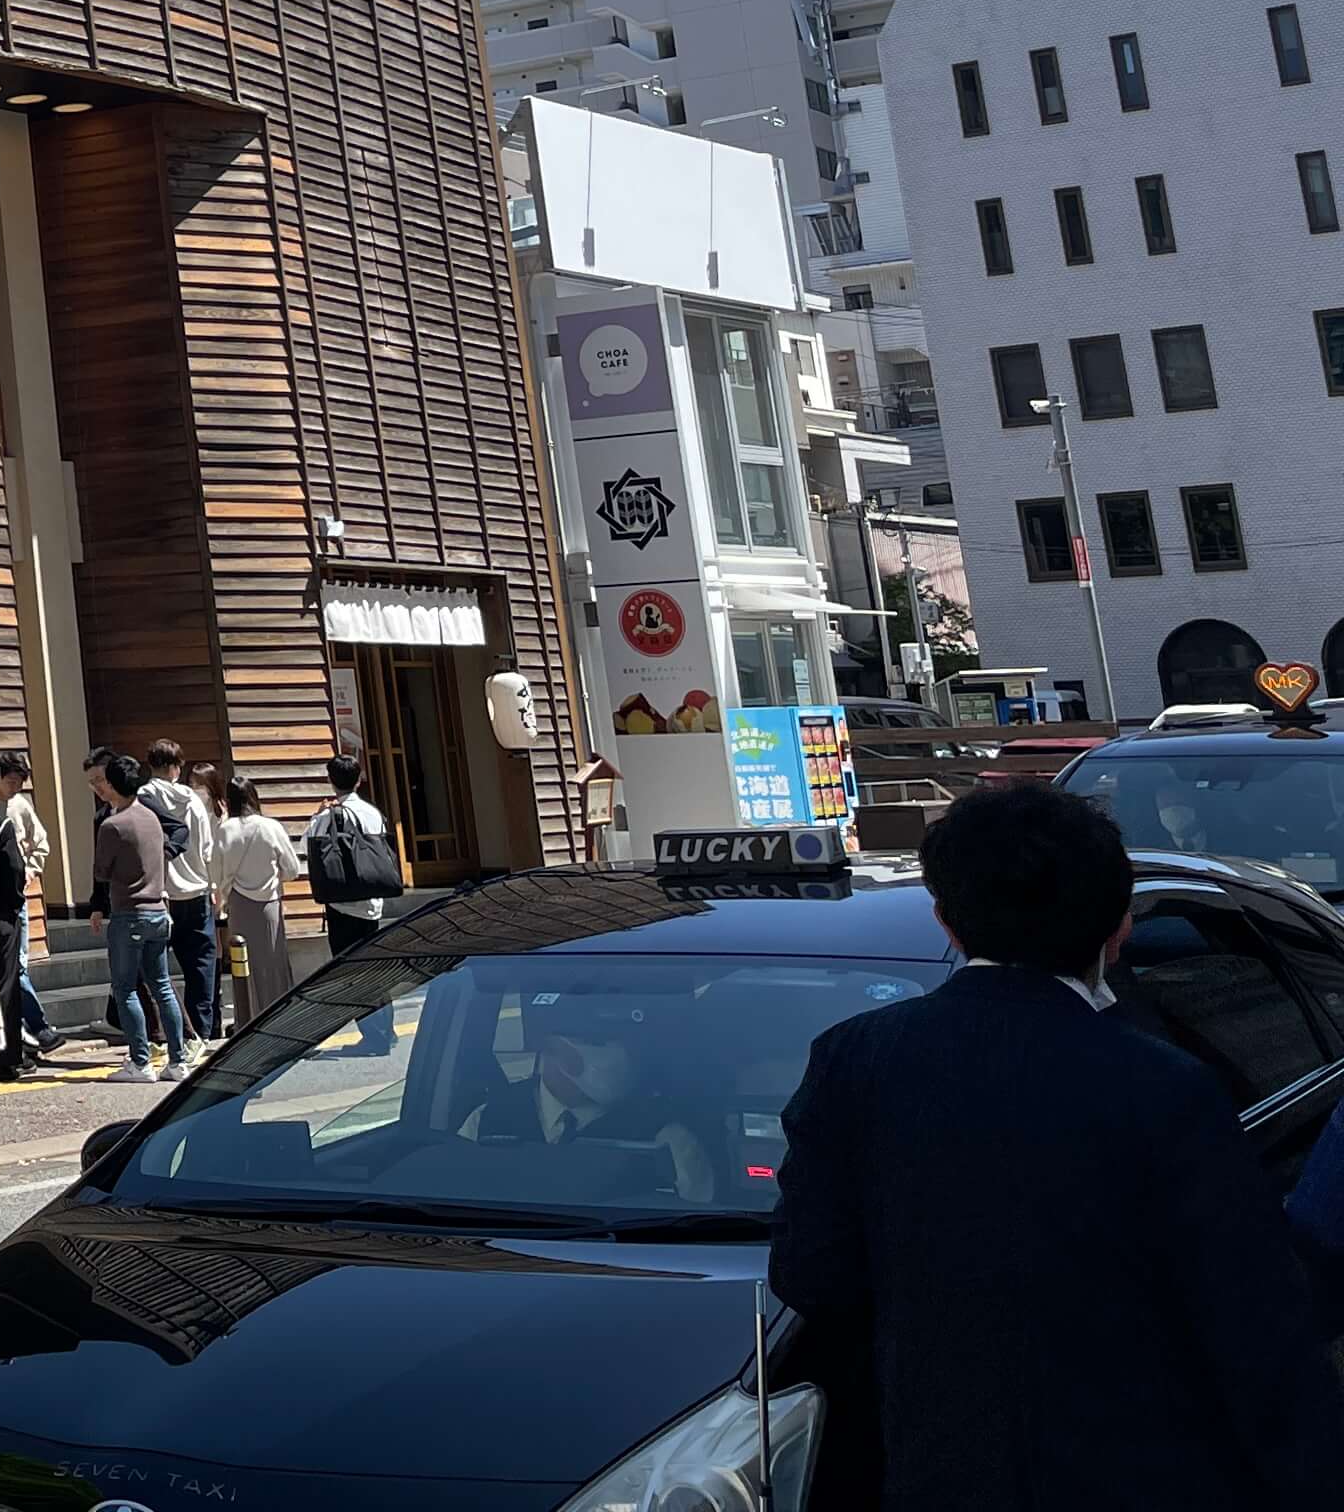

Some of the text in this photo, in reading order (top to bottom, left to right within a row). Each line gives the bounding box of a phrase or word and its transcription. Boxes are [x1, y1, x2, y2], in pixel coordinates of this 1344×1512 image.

[596, 348, 629, 359] CHOA
[600, 358, 629, 369] CAFE
[658, 835, 783, 864] LUCKY
[53, 1460, 148, 1481] SEVEN
[167, 1472, 238, 1502] TAXI
